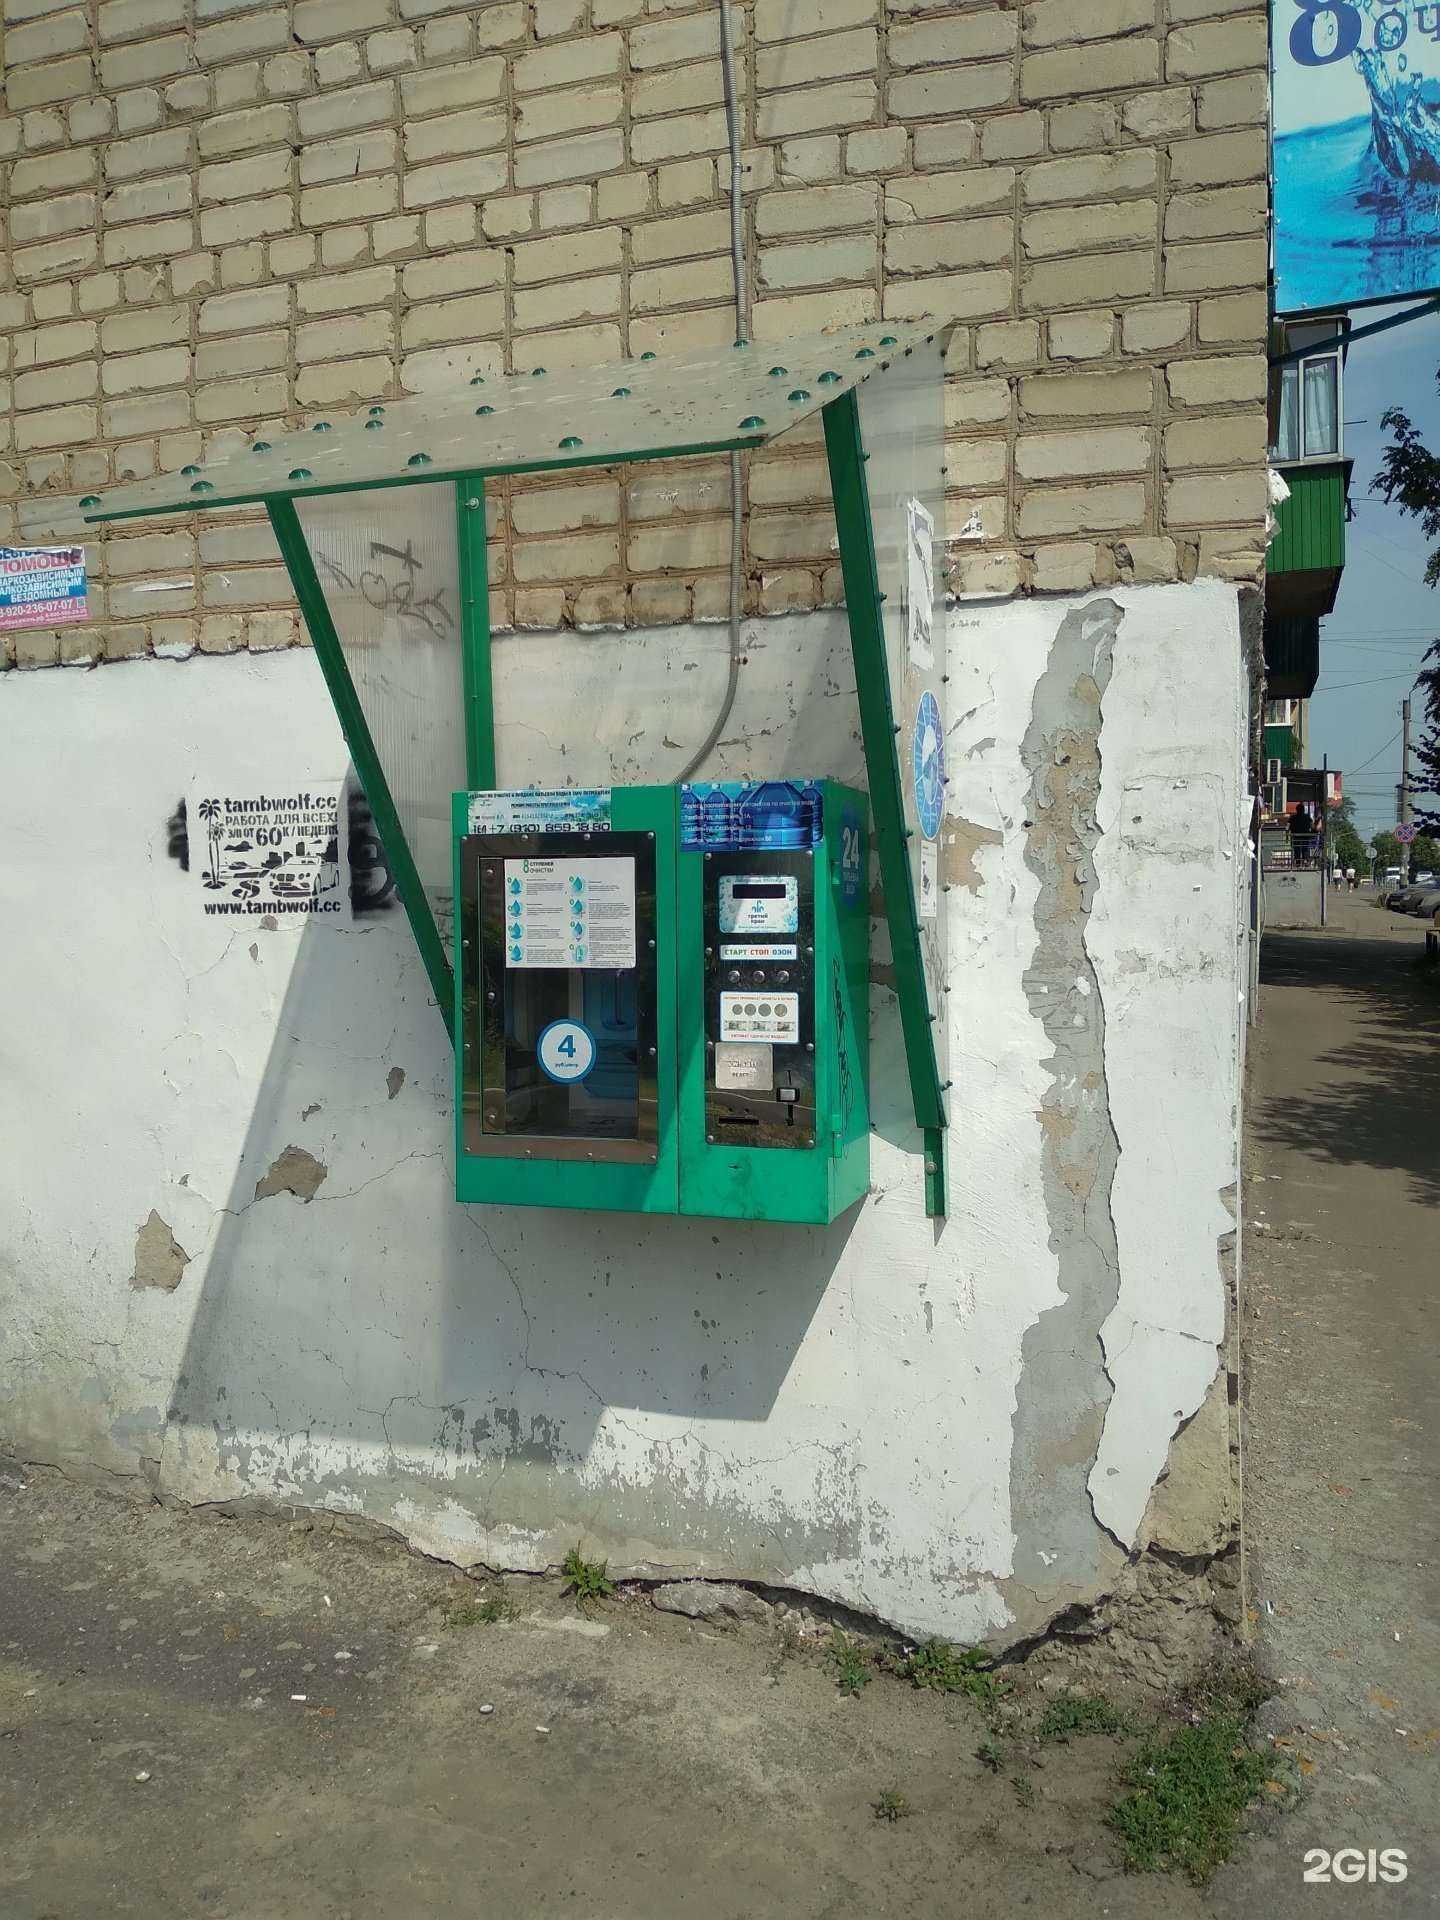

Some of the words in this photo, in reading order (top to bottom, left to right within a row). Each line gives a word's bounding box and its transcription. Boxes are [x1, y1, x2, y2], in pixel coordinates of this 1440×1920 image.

[11, 588, 70, 603] БЕЗДОМНЫМ
[224, 793, 337, 812] tambwolf.cc
[225, 814, 270, 826] РАБОТА
[273, 813, 299, 825] ДЛЯ
[243, 827, 254, 838] ОТ
[842, 826, 860, 870] 24
[204, 899, 341, 915] www.tambwolf.cc
[558, 1035, 576, 1058] 4
